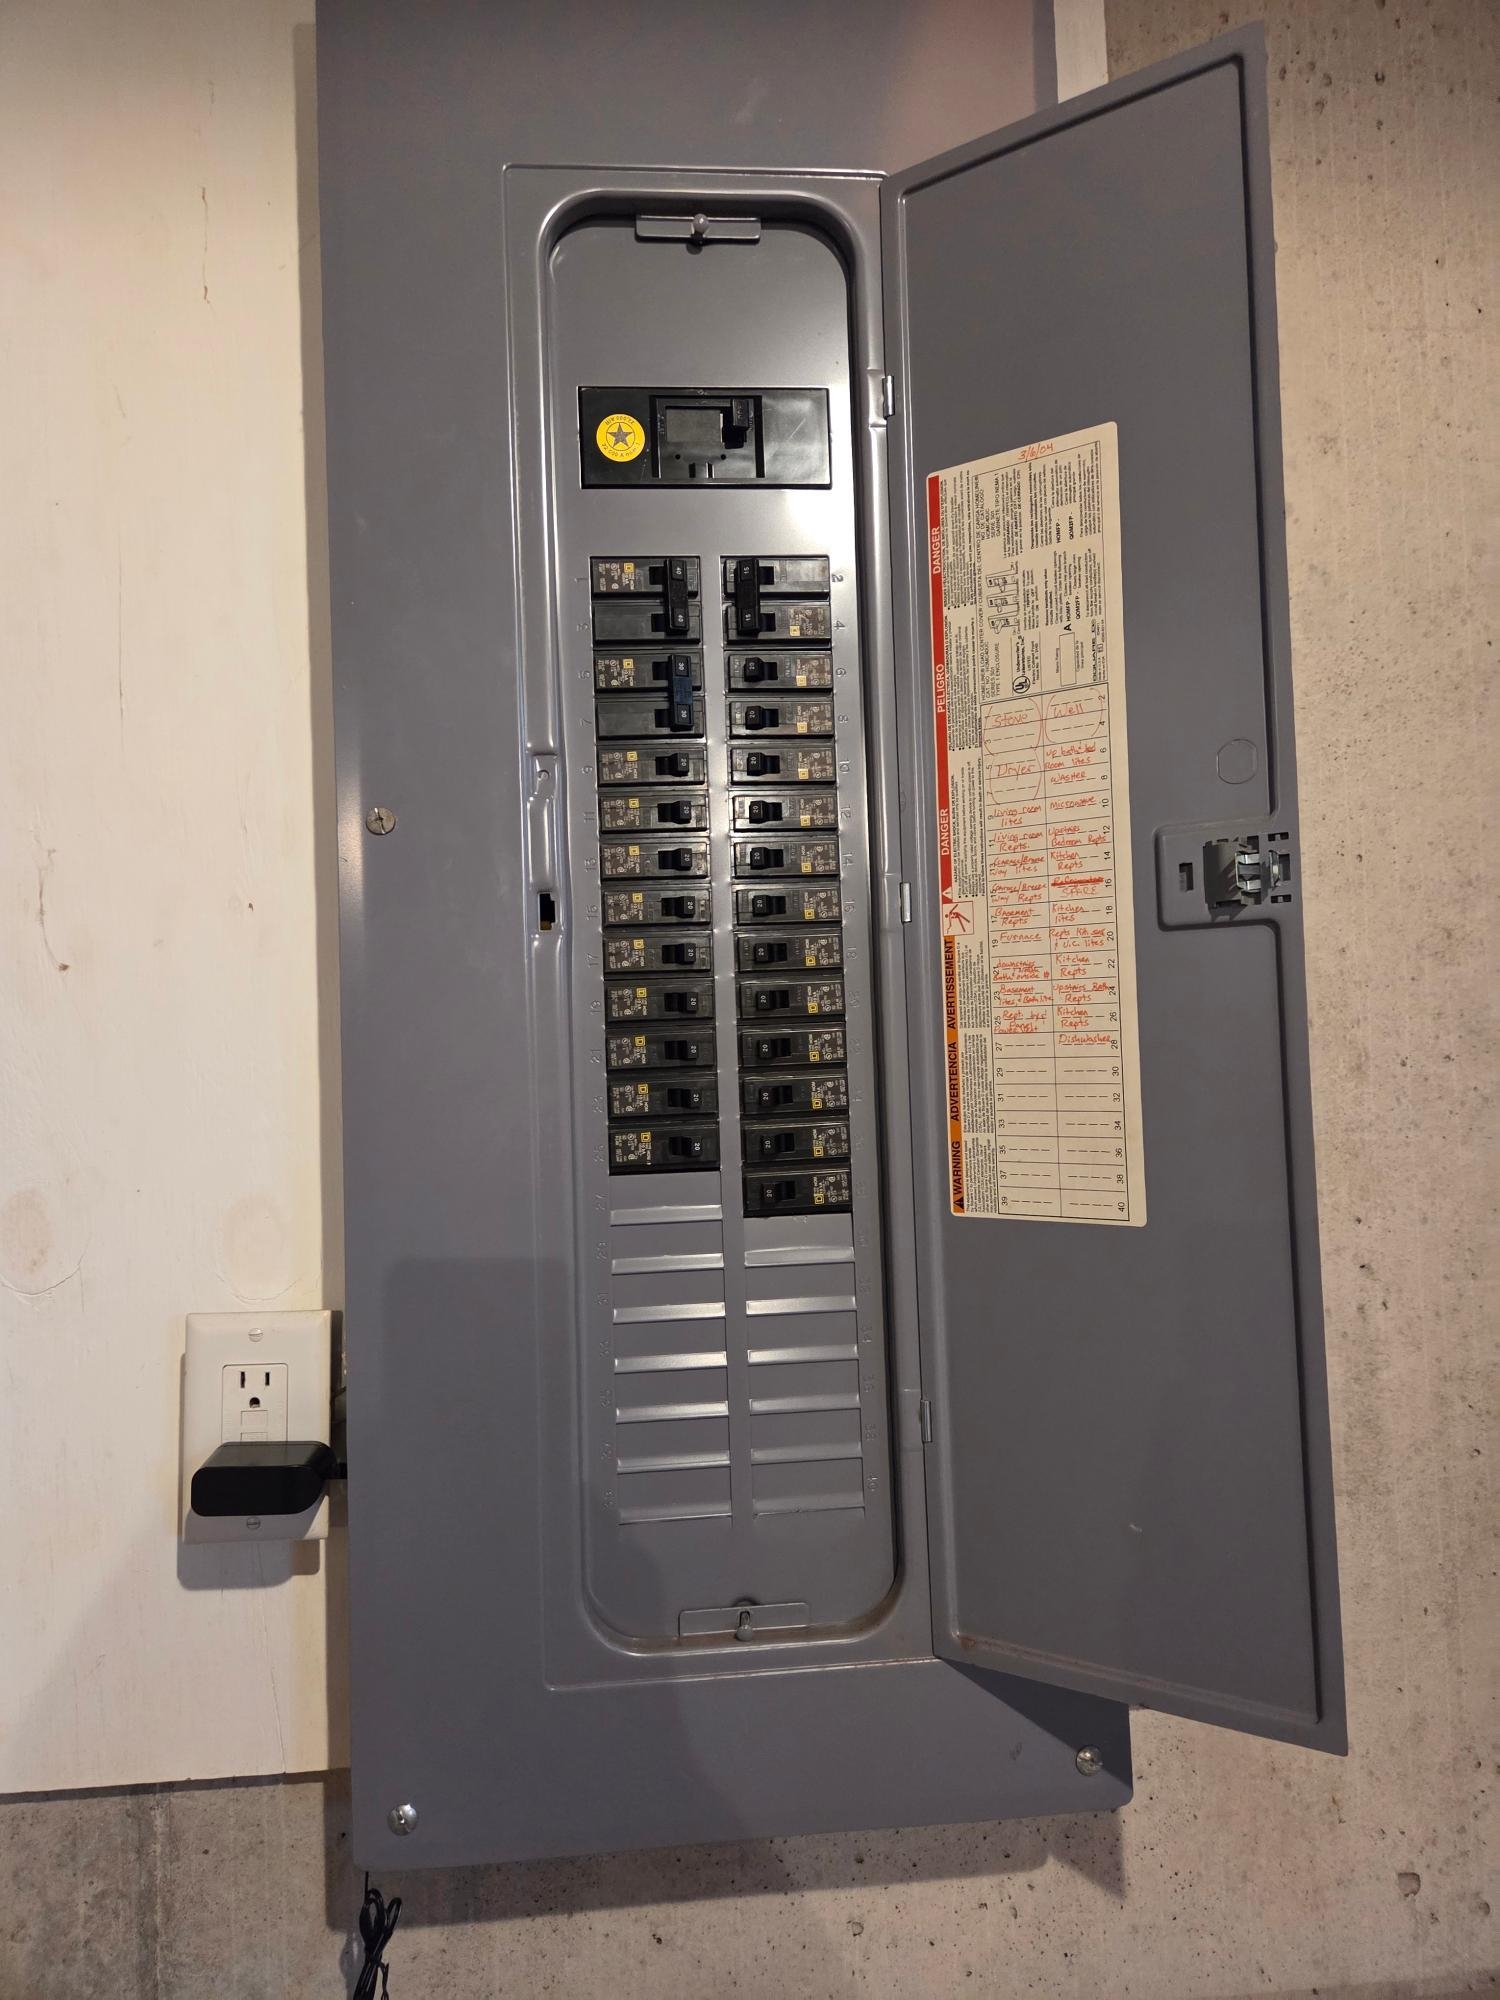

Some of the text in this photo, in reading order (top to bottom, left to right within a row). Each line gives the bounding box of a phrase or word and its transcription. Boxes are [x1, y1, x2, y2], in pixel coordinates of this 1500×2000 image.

[1017, 442, 1054, 460] 3/6/04
[932, 527, 941, 575] DANGER
[676, 567, 682, 575] 40
[743, 566, 750, 574] 15
[1063, 623, 1072, 632] A
[936, 663, 945, 713] PELIGRO
[681, 710, 687, 718] 30
[1054, 704, 1084, 718] Well
[680, 758, 687, 767] 20
[750, 756, 757, 765] 20
[997, 763, 1035, 780] Dryer
[1102, 798, 1109, 808] 10
[684, 806, 690, 814] 20
[752, 805, 759, 813] 20
[940, 808, 950, 856] DANGER
[1103, 825, 1110, 834] 12
[684, 854, 690, 862] 20
[754, 852, 760, 861] 20
[1050, 849, 1080, 860] Kitchen
[1104, 850, 1111, 860] 14
[1105, 878, 1112, 888] 16
[687, 901, 694, 910] 20
[756, 899, 763, 908] 20
[1052, 903, 1085, 914] Kitchen
[1106, 905, 1113, 914] 18
[991, 915, 998, 923] 17
[1000, 931, 1041, 941] Furnace
[1106, 930, 1114, 941] 20
[992, 939, 999, 948] 19
[688, 948, 694, 957] 20
[758, 947, 764, 956] 20
[1055, 954, 1089, 965] Kitchen
[1107, 958, 1115, 969] 22
[944, 940, 956, 1030] AVERTISSEMENT
[1109, 985, 1117, 995] 24
[760, 995, 766, 1003] 20
[993, 990, 1000, 1000] 23
[690, 997, 697, 1006] 20
[1057, 1006, 1089, 1016] Kitchen
[1110, 1011, 1118, 1021] 26
[994, 1015, 1001, 1025] 25
[762, 1044, 768, 1053] 20
[995, 1041, 1002, 1051] 27
[1110, 1039, 1119, 1049] 28
[690, 1045, 697, 1054] 20
[996, 1067, 1004, 1077] 29
[1112, 1066, 1120, 1076] 30
[948, 1042, 960, 1122] ADVERTENCIA
[693, 1094, 699, 1102] 20
[762, 1092, 768, 1100] 20
[997, 1093, 1004, 1102] 31
[1113, 1092, 1121, 1102] 32
[998, 1119, 1006, 1128] 33
[1114, 1120, 1122, 1130] 34
[694, 1142, 700, 1151] 20
[765, 1140, 771, 1149] 20
[999, 1144, 1007, 1154] 35
[1115, 1147, 1123, 1158] 36
[951, 1141, 962, 1195] WARNING
[1000, 1170, 1008, 1179] 37
[1116, 1174, 1125, 1184] 38
[766, 1189, 772, 1198] 20
[1001, 1196, 1009, 1206] 39
[1117, 1202, 1125, 1212] 40
